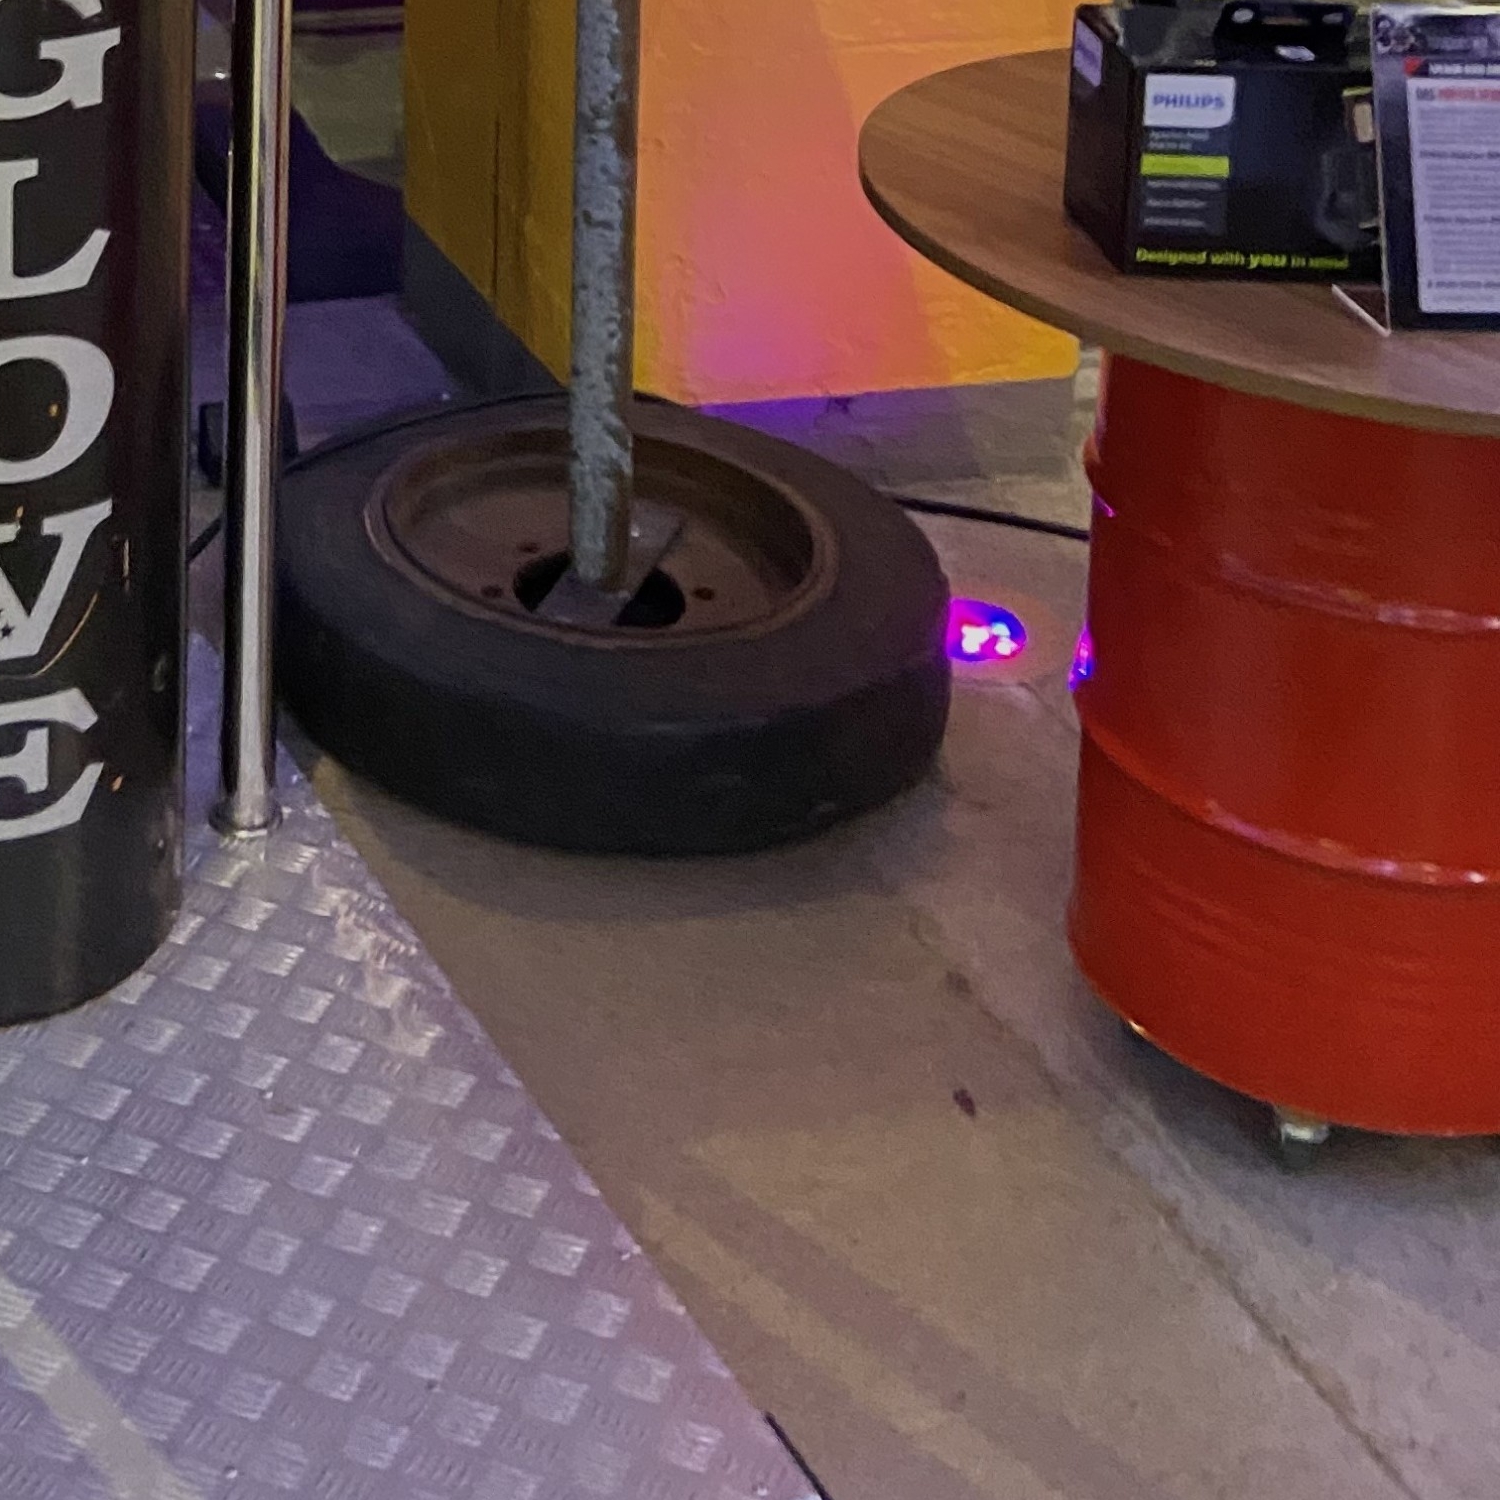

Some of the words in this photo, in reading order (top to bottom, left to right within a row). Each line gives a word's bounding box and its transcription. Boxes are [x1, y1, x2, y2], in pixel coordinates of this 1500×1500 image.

[1152, 93, 1226, 111] PHILIPS
[1135, 247, 1207, 266] Designed
[1210, 251, 1245, 266] with
[1247, 252, 1287, 270] you
